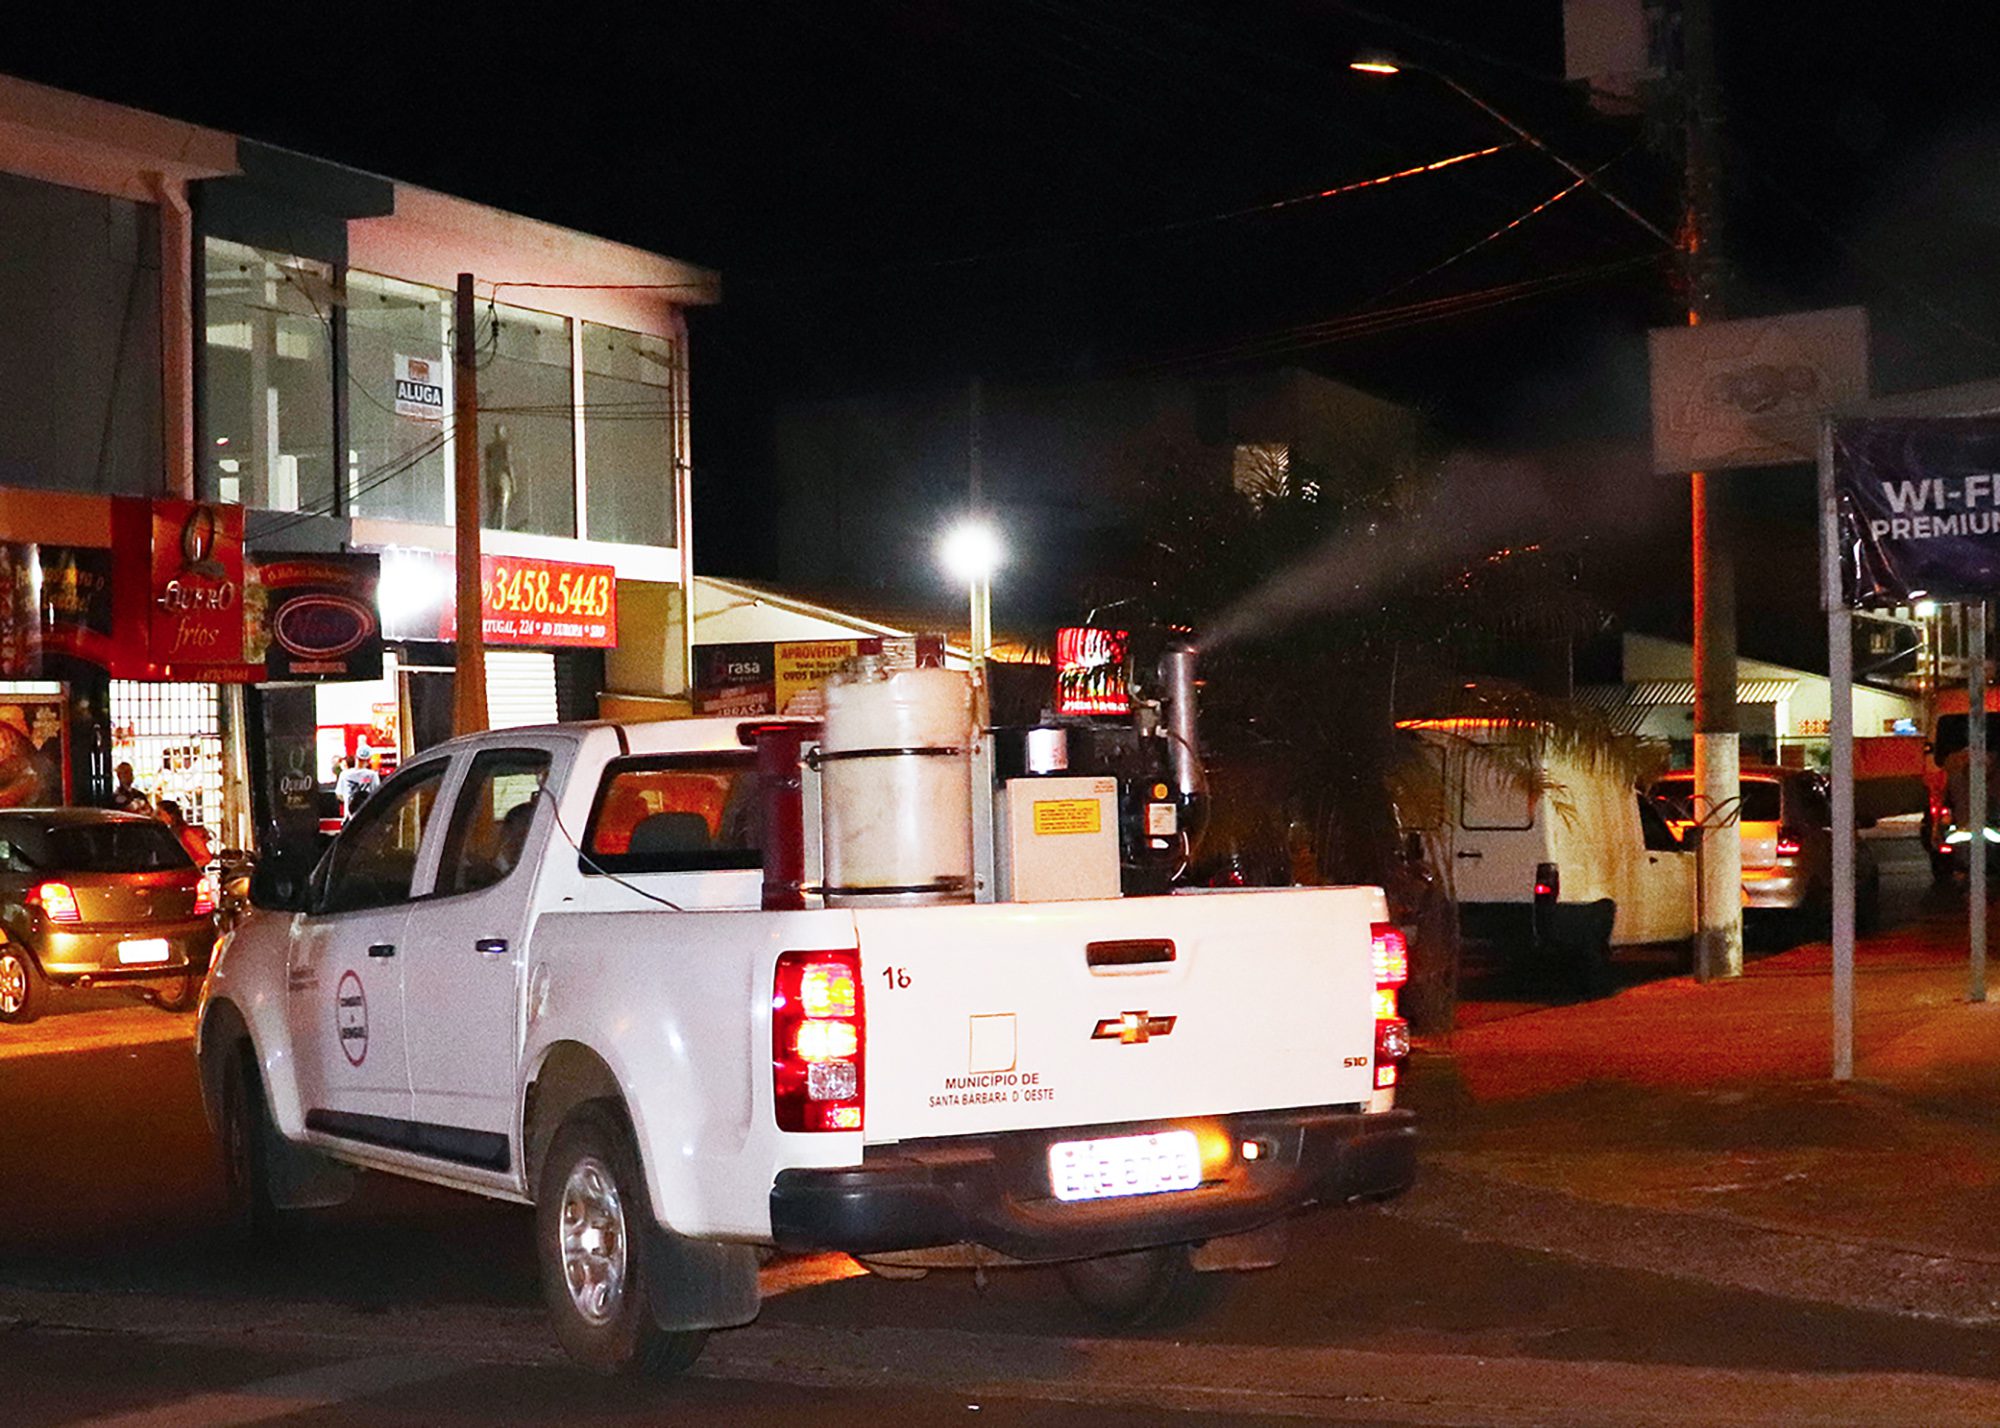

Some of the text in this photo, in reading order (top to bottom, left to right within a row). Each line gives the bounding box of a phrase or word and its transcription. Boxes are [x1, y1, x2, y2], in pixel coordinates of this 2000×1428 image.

[397, 382, 441, 405] ALUGA
[1881, 473, 2000, 513] WI-FI
[492, 567, 609, 617] 3458.5443
[168, 615, 220, 654] frios
[1343, 1056, 1368, 1069] S10
[1021, 1073, 1040, 1086] DE
[929, 1095, 960, 1108] SANTA
